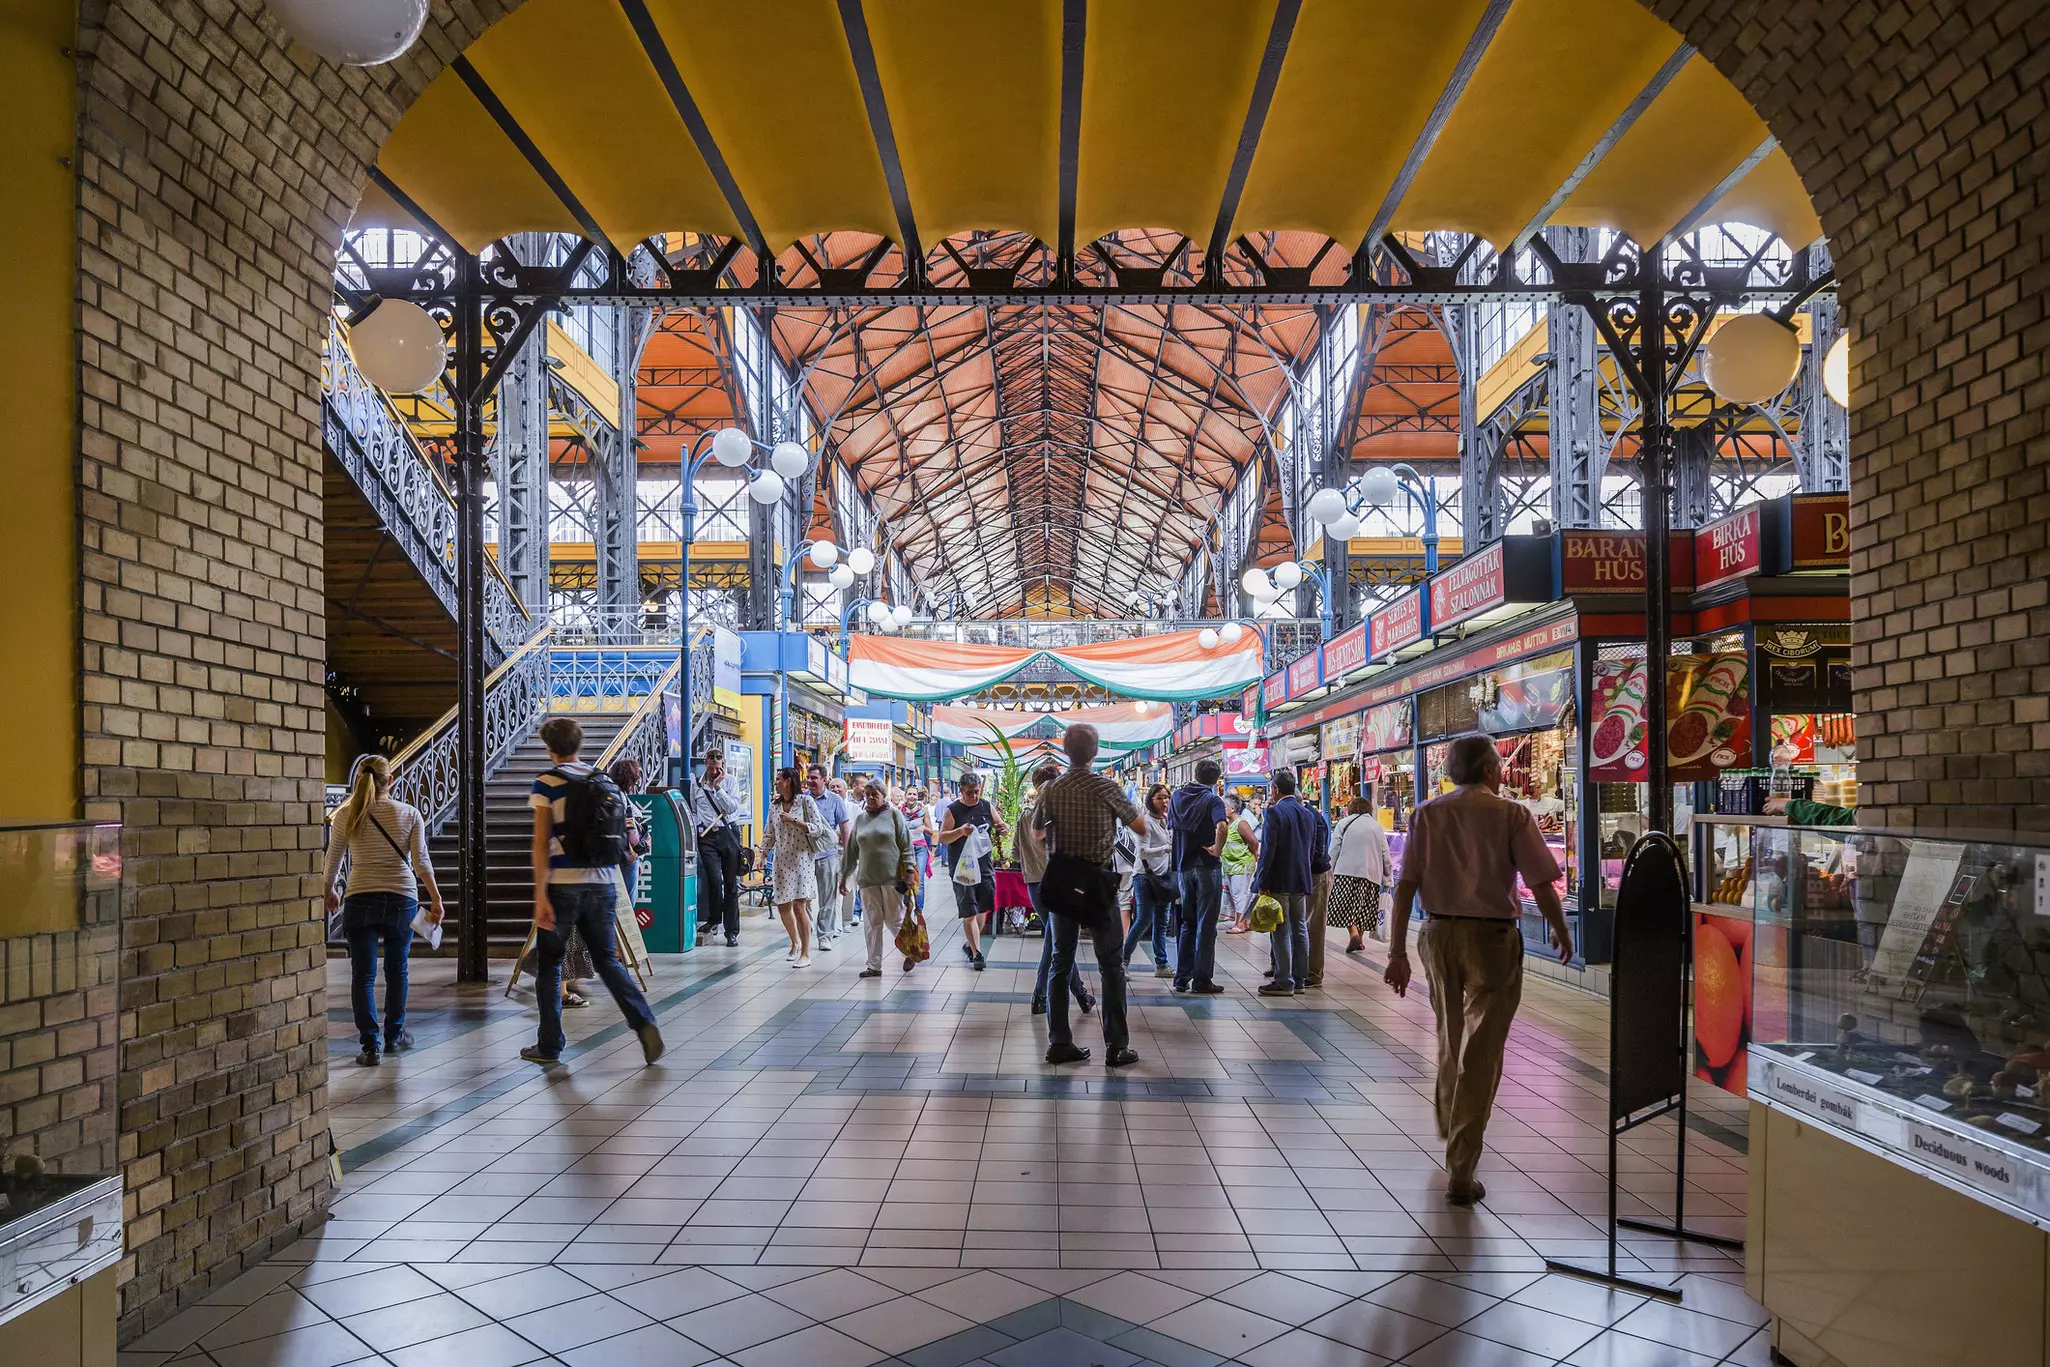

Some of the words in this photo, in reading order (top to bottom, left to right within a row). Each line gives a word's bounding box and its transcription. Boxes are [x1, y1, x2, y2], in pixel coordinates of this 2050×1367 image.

[1712, 514, 1752, 550] BIRKA
[1824, 513, 1849, 553] B
[1594, 557, 1644, 580] HÚS
[1720, 540, 1746, 570] HÚS
[1524, 631, 1548, 650] MUTTON
[1767, 643, 1781, 654] REX
[1782, 643, 1817, 656] CIBORUM
[1776, 1077, 1817, 1104] Lomberdei
[1820, 1098, 1853, 1120] gombák
[1915, 1133, 1968, 1167] Deciduous
[1974, 1160, 2010, 1184] woods
